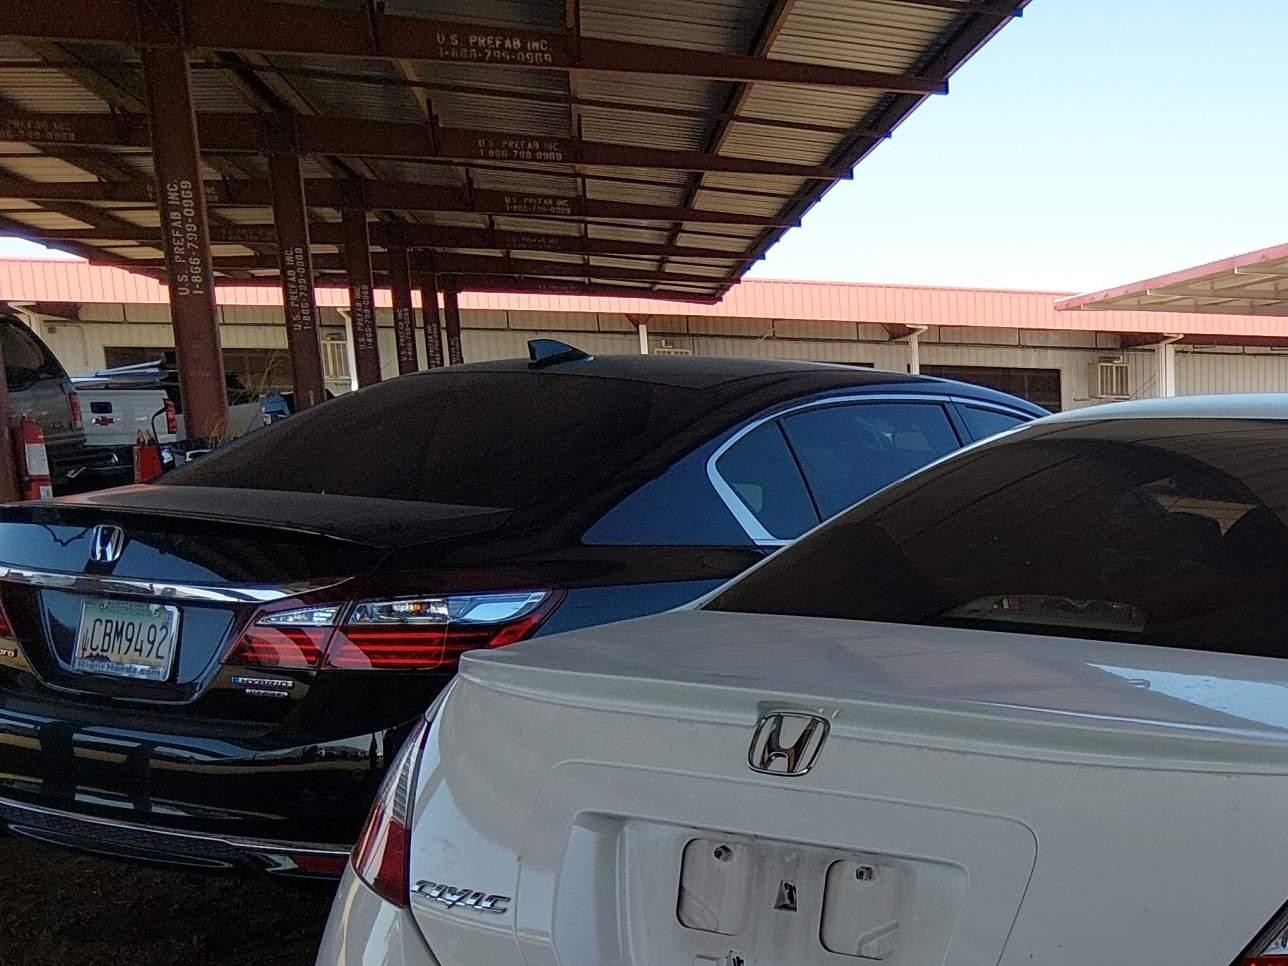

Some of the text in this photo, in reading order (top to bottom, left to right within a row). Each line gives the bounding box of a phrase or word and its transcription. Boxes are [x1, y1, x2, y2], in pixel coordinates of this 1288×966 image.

[469, 35, 521, 50] PREFAB
[527, 40, 553, 52] INC.
[166, 180, 181, 206] INC.
[169, 211, 187, 263] PREFAB
[90, 618, 169, 660] CBM9492
[411, 880, 511, 914] CIVIC
